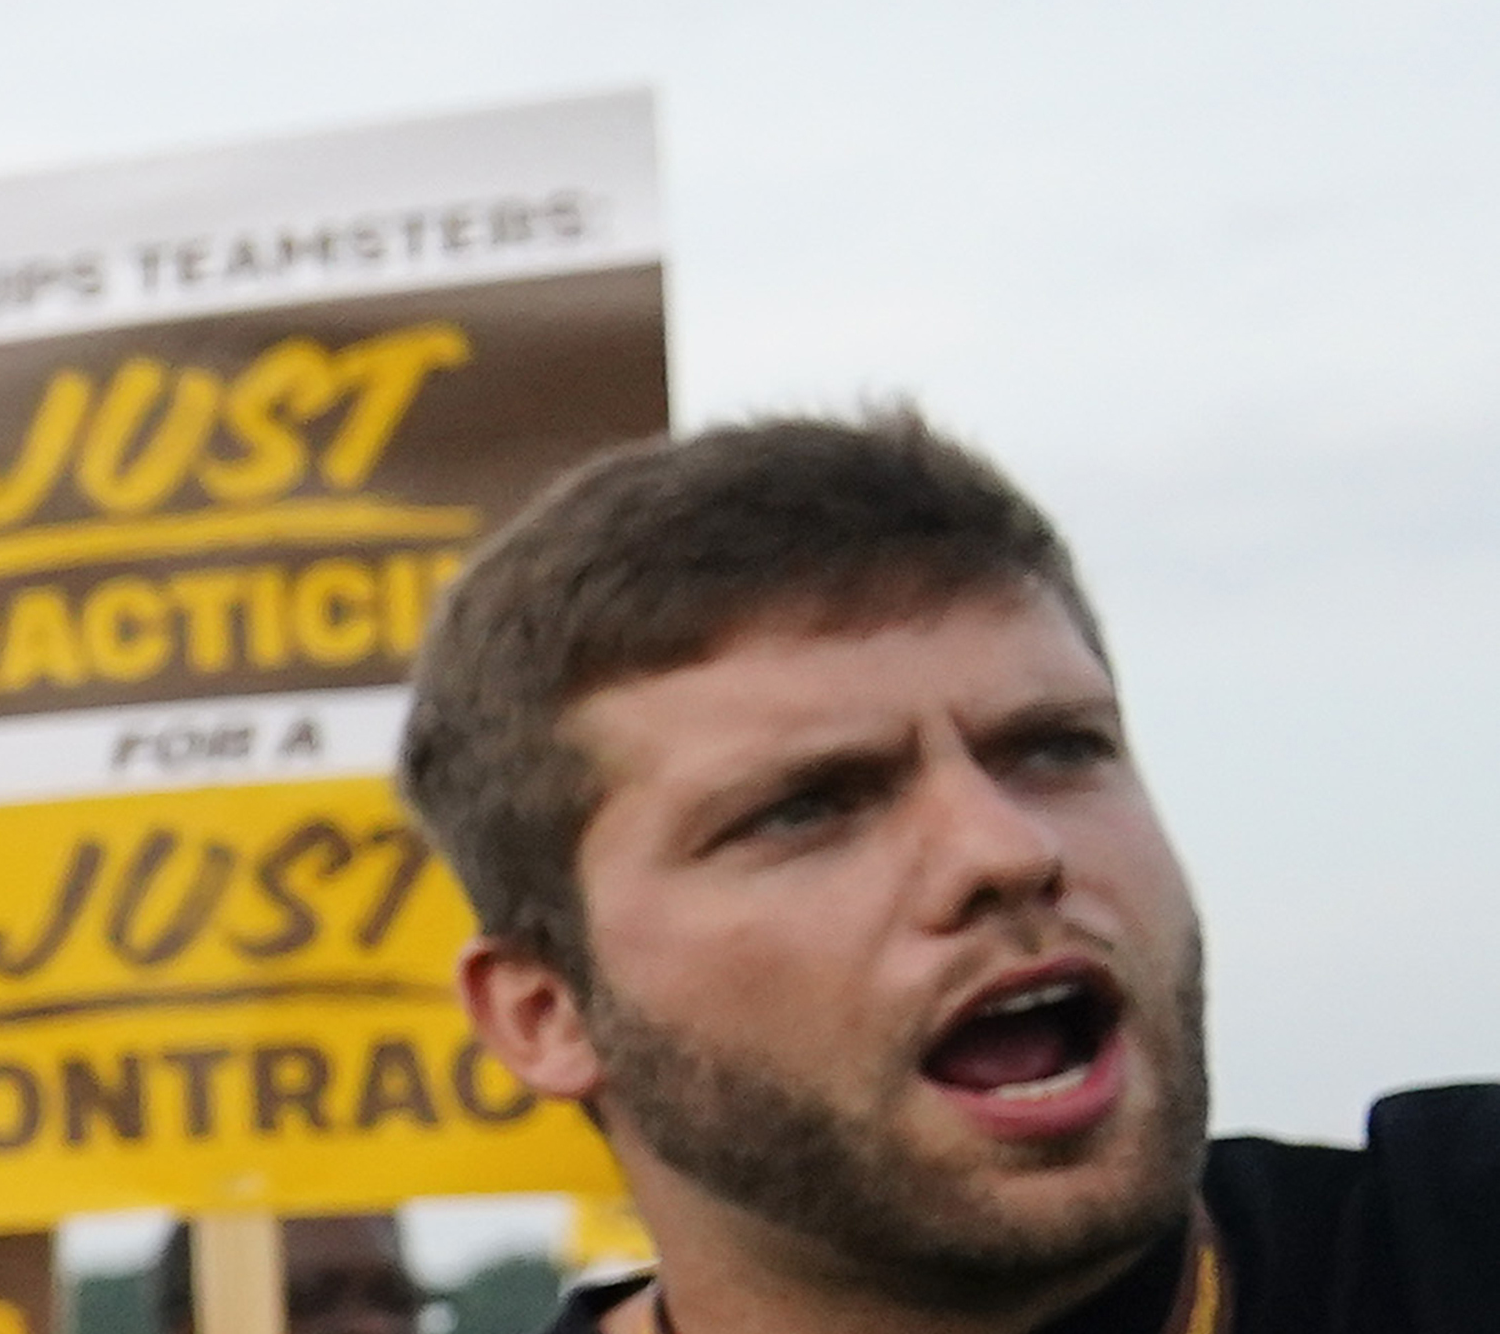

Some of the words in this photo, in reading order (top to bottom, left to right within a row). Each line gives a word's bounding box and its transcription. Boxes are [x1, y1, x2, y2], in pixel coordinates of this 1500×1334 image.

[128, 189, 586, 296] TEAMSTERS
[110, 727, 253, 769] FOR
[276, 717, 324, 759] A
